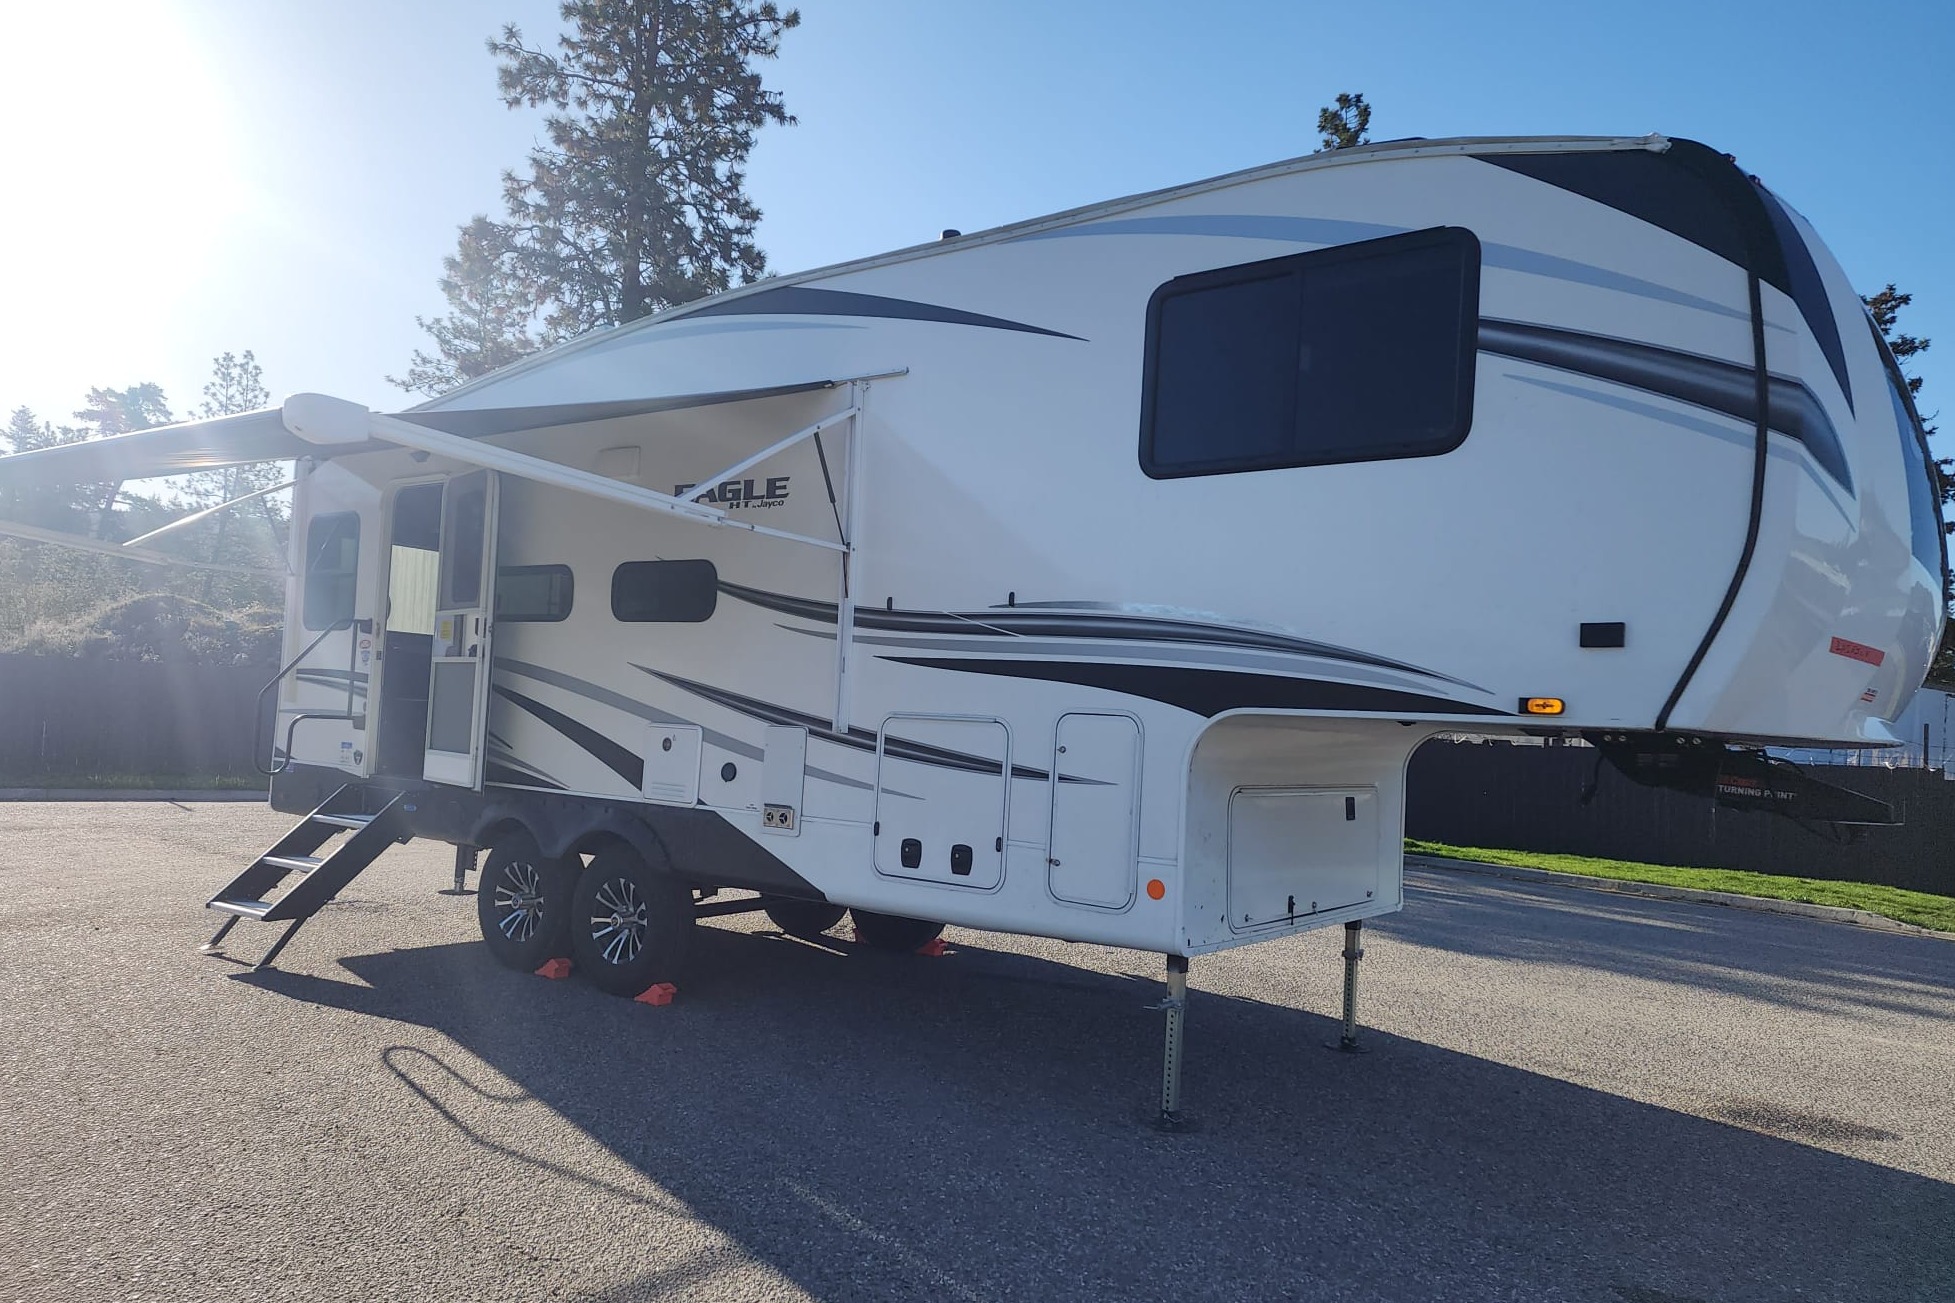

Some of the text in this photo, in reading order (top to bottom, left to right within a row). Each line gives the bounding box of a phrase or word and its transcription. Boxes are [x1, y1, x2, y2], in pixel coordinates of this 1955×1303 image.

[729, 500, 752, 509] HT
[757, 499, 785, 509] Jayco
[1717, 784, 1797, 800] TURNING PINT
